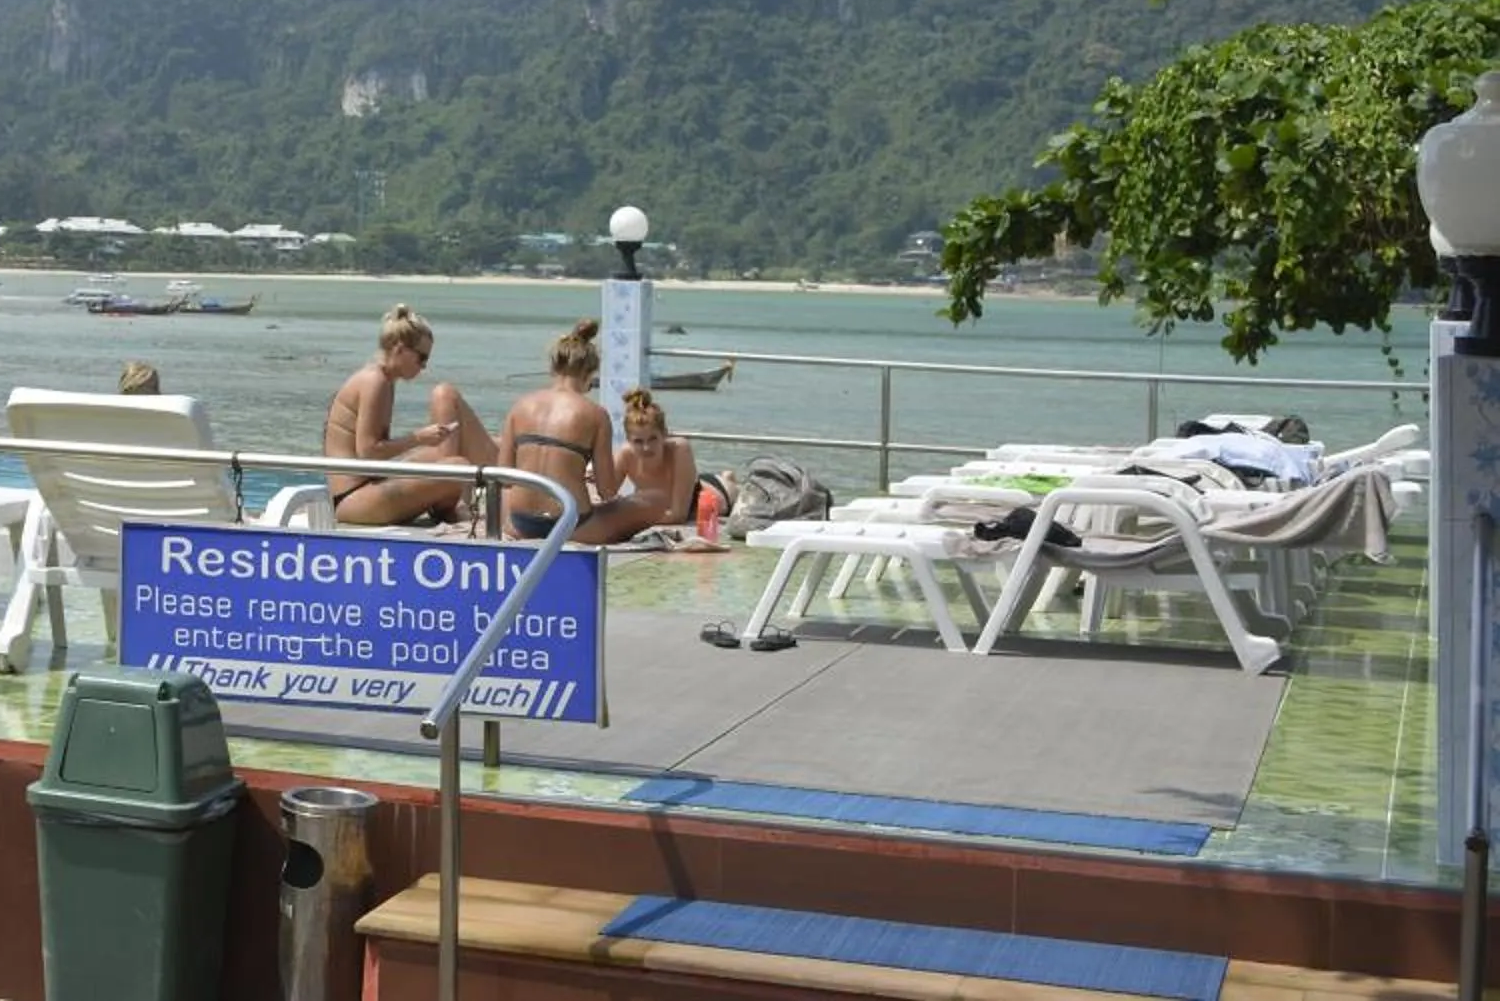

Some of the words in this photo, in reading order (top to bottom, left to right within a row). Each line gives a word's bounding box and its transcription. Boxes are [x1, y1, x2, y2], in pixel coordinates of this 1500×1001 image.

[161, 536, 397, 586] Resident
[414, 549, 524, 591] Onl
[135, 584, 231, 618] Please
[248, 598, 361, 627] remove
[379, 600, 455, 632] shoe
[474, 604, 577, 638] bfore
[175, 626, 303, 660] entering
[321, 632, 373, 659] the
[392, 639, 459, 667] pool
[184, 660, 271, 690] Thank
[279, 672, 338, 698] you
[351, 678, 416, 703] very
[462, 684, 531, 707] uch
